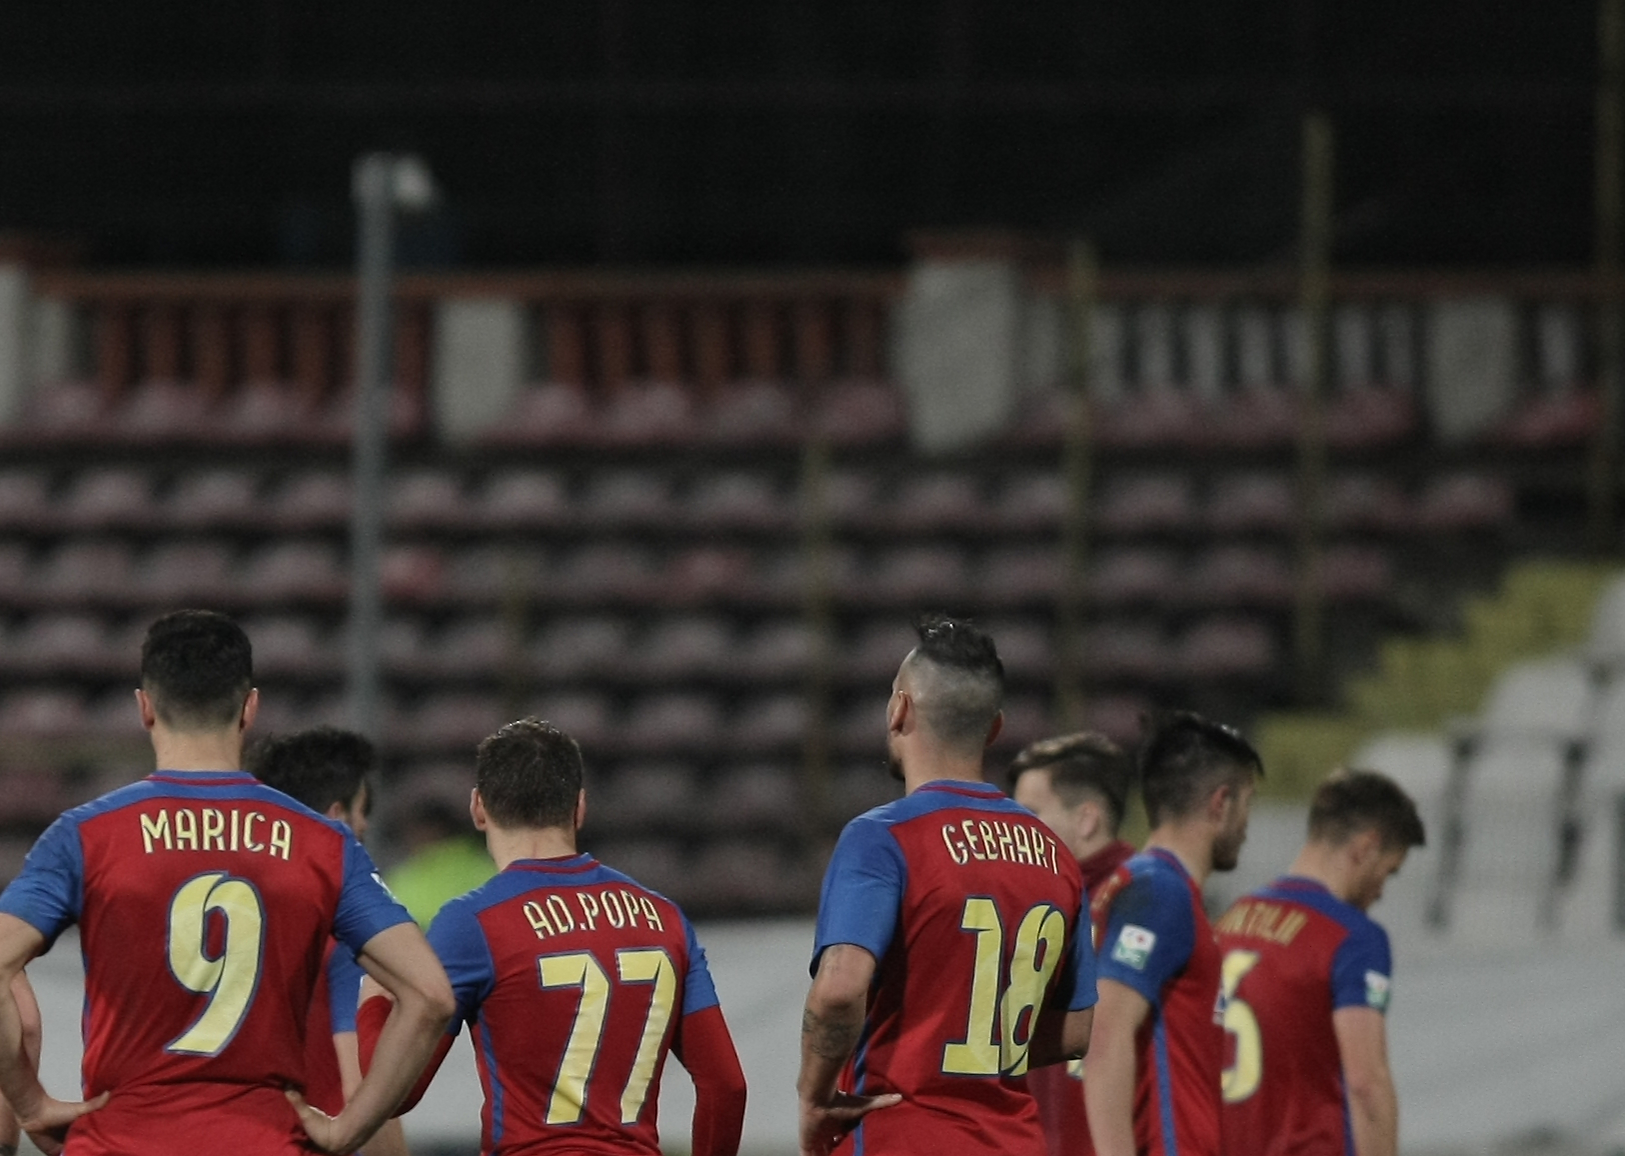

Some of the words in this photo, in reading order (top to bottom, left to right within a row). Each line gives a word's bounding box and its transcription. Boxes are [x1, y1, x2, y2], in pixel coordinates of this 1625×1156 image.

[139, 808, 292, 861] MARICA
[941, 819, 1059, 876] GEBHART
[165, 871, 266, 1057] 9
[537, 948, 677, 1126] 77
[940, 895, 1067, 1078] 18
